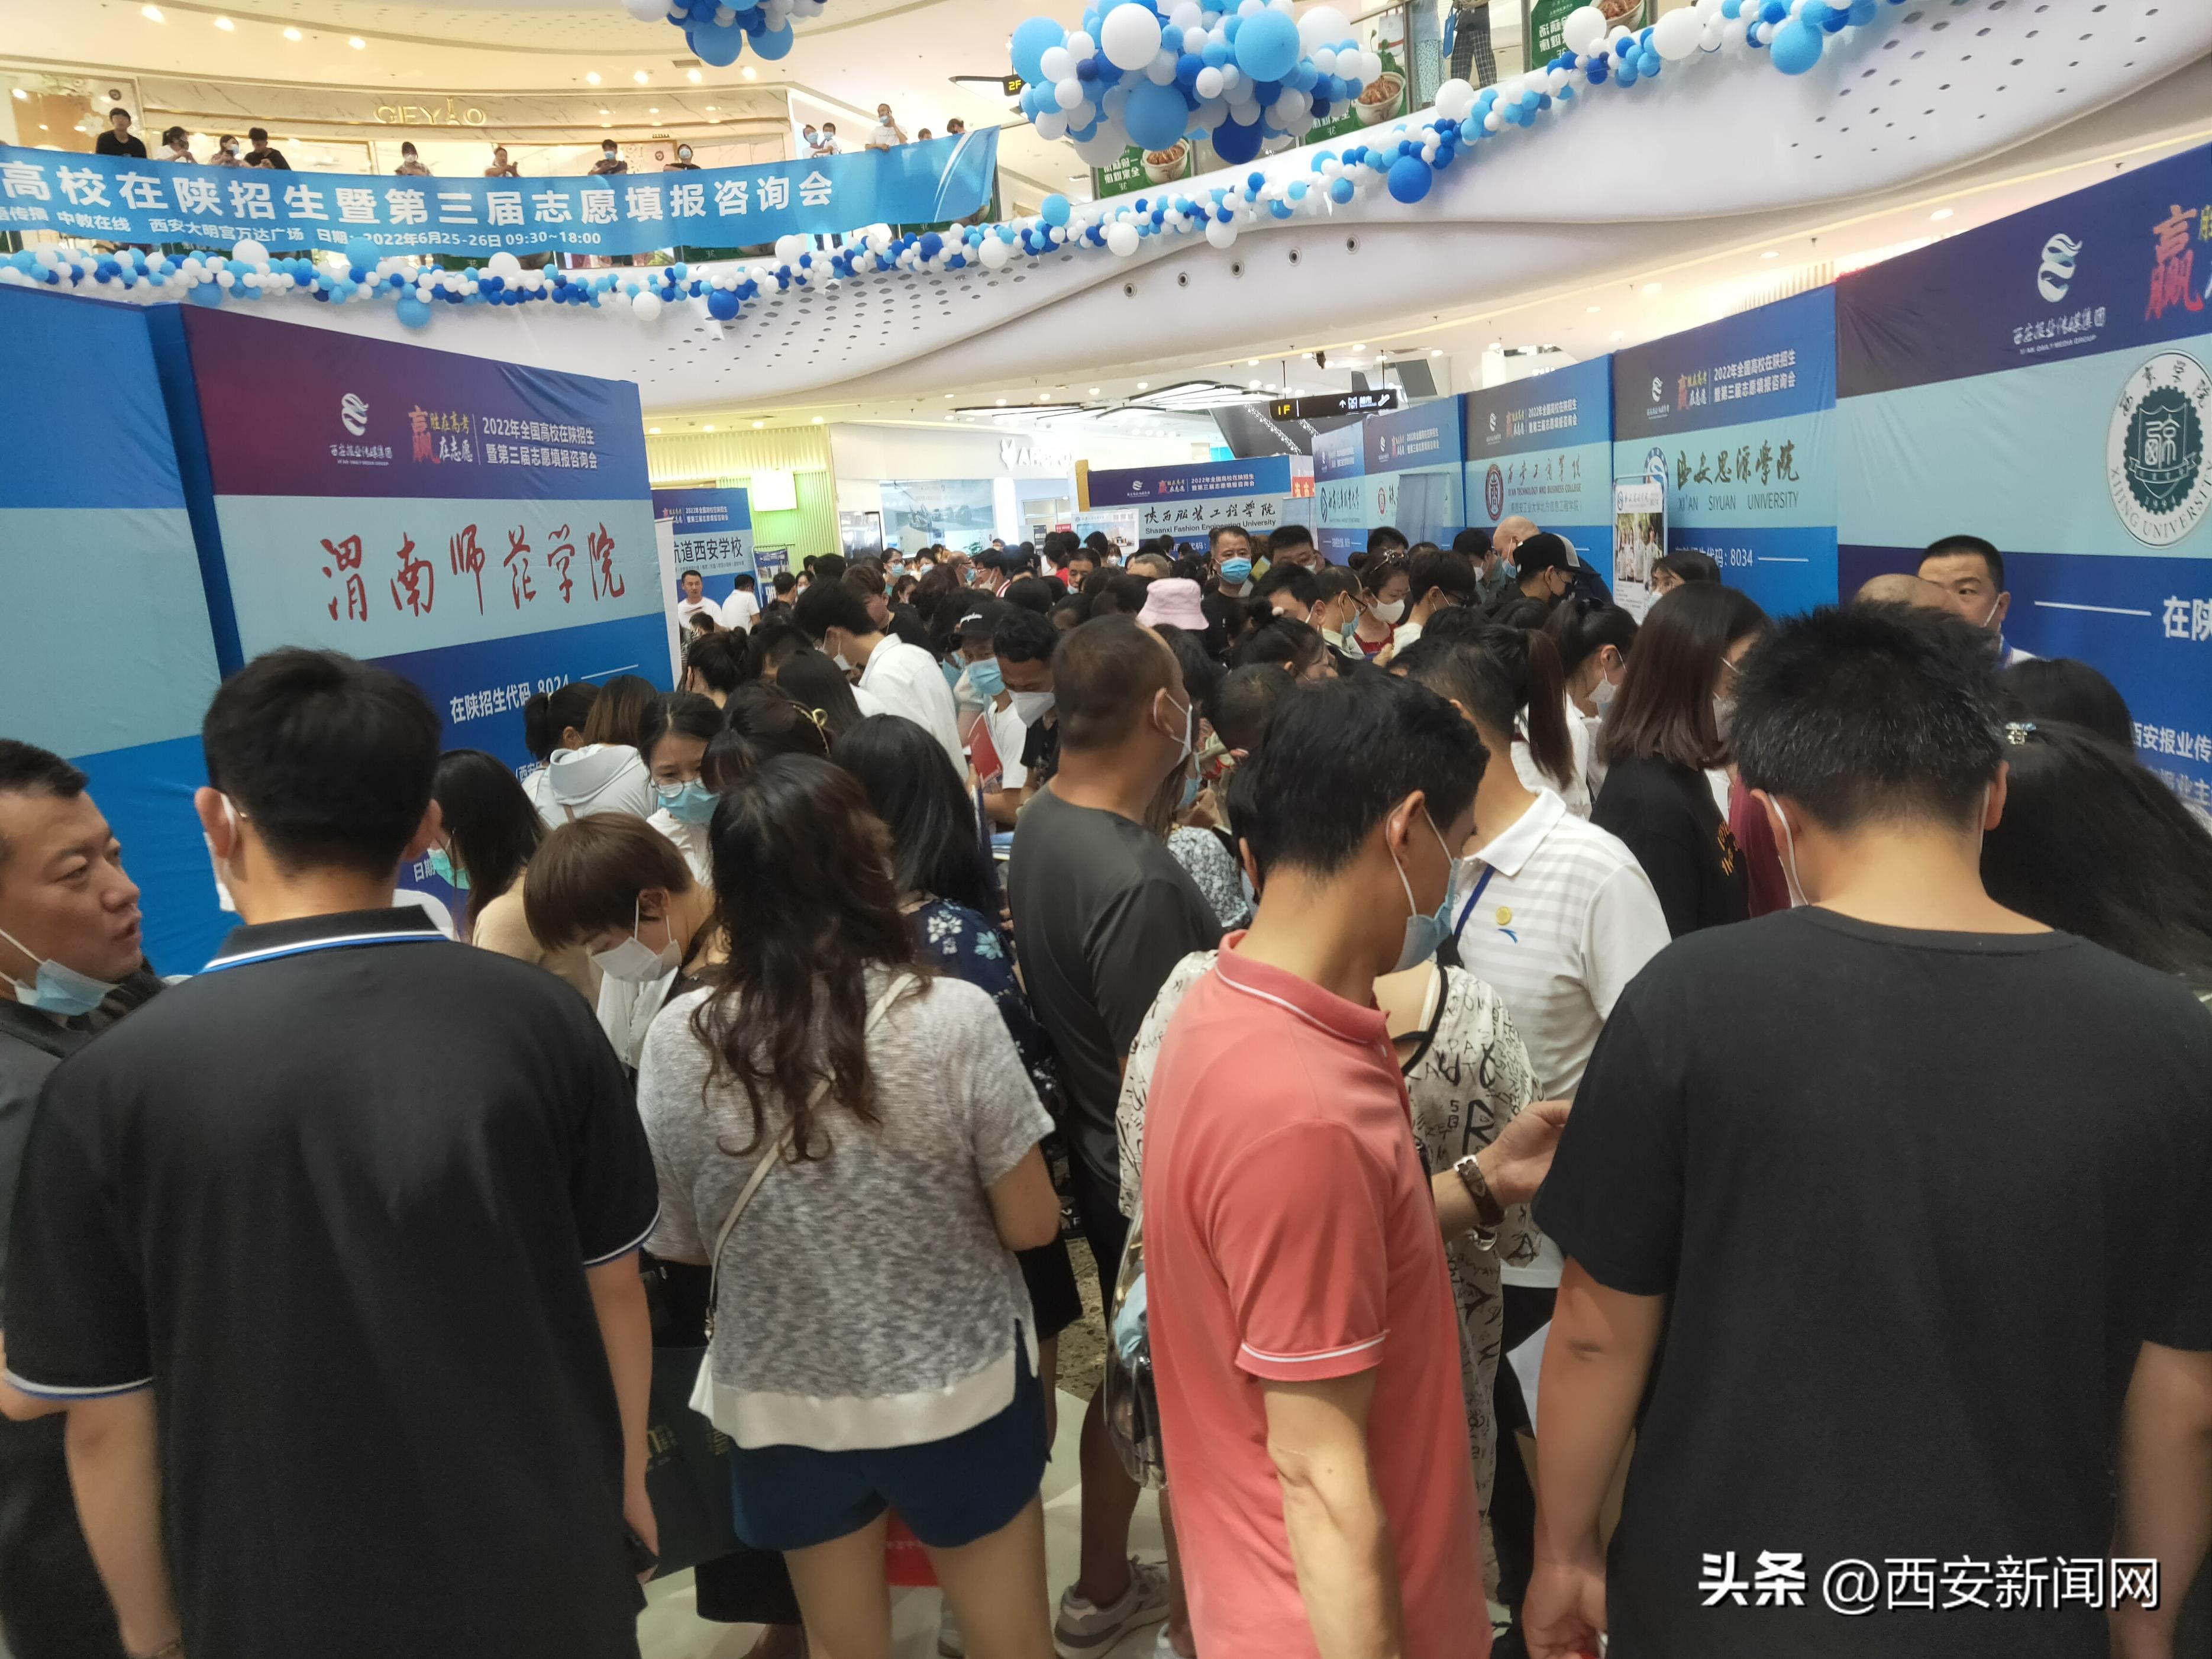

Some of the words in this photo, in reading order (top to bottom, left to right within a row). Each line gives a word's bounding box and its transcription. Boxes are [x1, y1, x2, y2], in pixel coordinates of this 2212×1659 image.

[1009, 79, 1021, 91] 2F
[0, 161, 832, 226] 高校在陕招生暨第三届志愿填报咨询会
[56, 211, 131, 232] 中教在线
[148, 218, 303, 242] 西安大明宫万达广场
[506, 231, 602, 246] 09:30~18:00
[1714, 348, 1796, 381] 2022年全国高校在陕招生
[1714, 370, 1796, 402] 暨第三届志愿填报咨询会
[430, 411, 470, 435] 胜在高考
[1278, 404, 1290, 415] 1F
[408, 405, 441, 463] 赢
[482, 417, 595, 446] 2022年全国高校在陕招生
[439, 435, 473, 462] 在志愿
[485, 444, 598, 469] 暨第三届志愿填报咨询会
[1678, 494, 1698, 512] XI'AN
[1709, 495, 1736, 511] SIYUAN
[1748, 491, 1799, 510] UNIVERSITY
[1145, 526, 1172, 534] Shaanxi
[1174, 524, 1200, 532] Fashion
